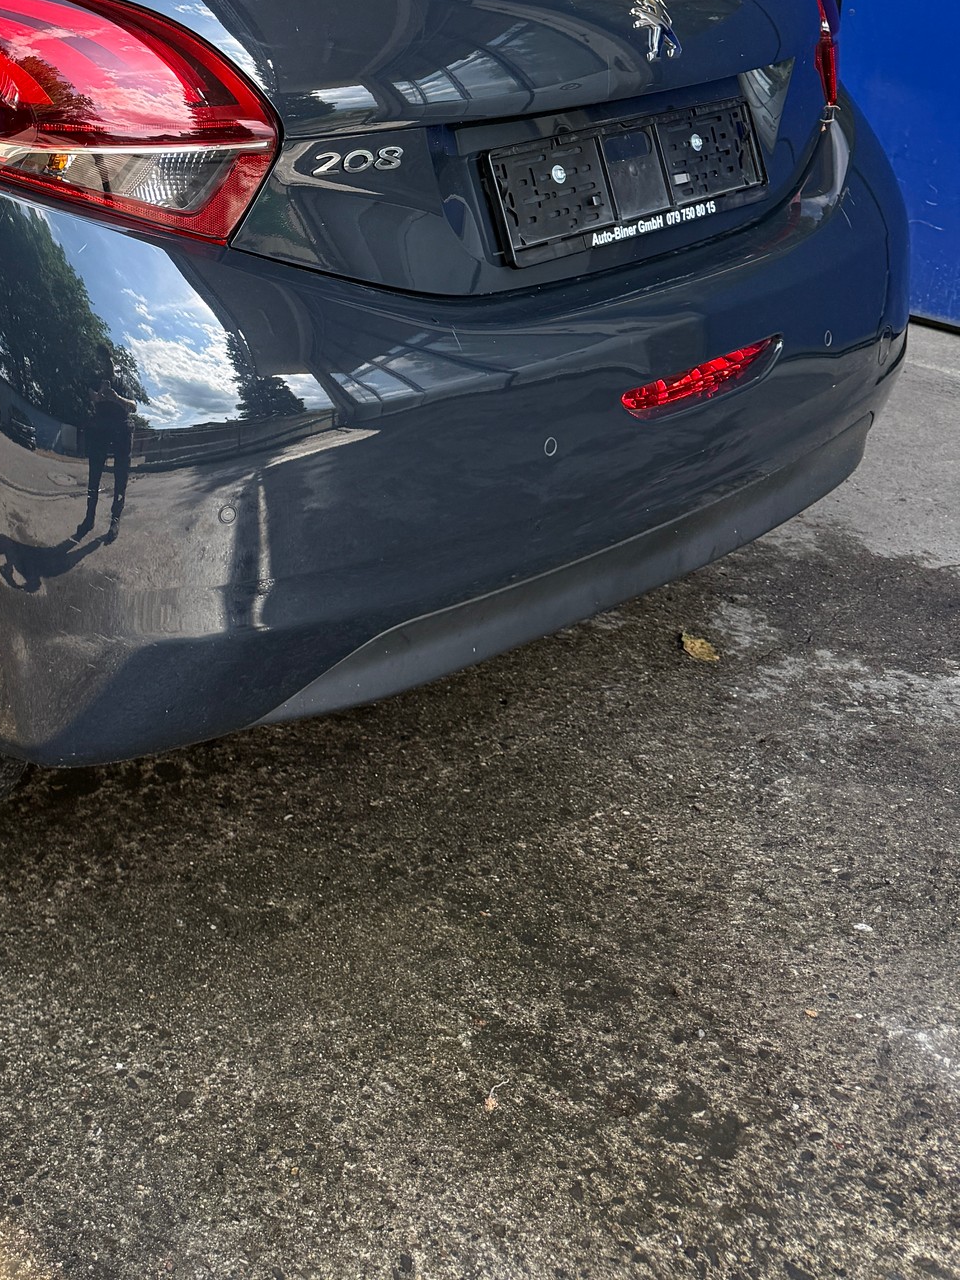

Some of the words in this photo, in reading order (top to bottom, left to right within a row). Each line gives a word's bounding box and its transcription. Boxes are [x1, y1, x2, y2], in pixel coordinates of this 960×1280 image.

[312, 146, 404, 177] 208
[592, 224, 637, 247] Auto-Biner
[637, 215, 664, 233] GmbH
[666, 210, 681, 225] 079
[681, 206, 695, 221] 750
[695, 203, 706, 217] 80
[706, 200, 716, 214] 15
